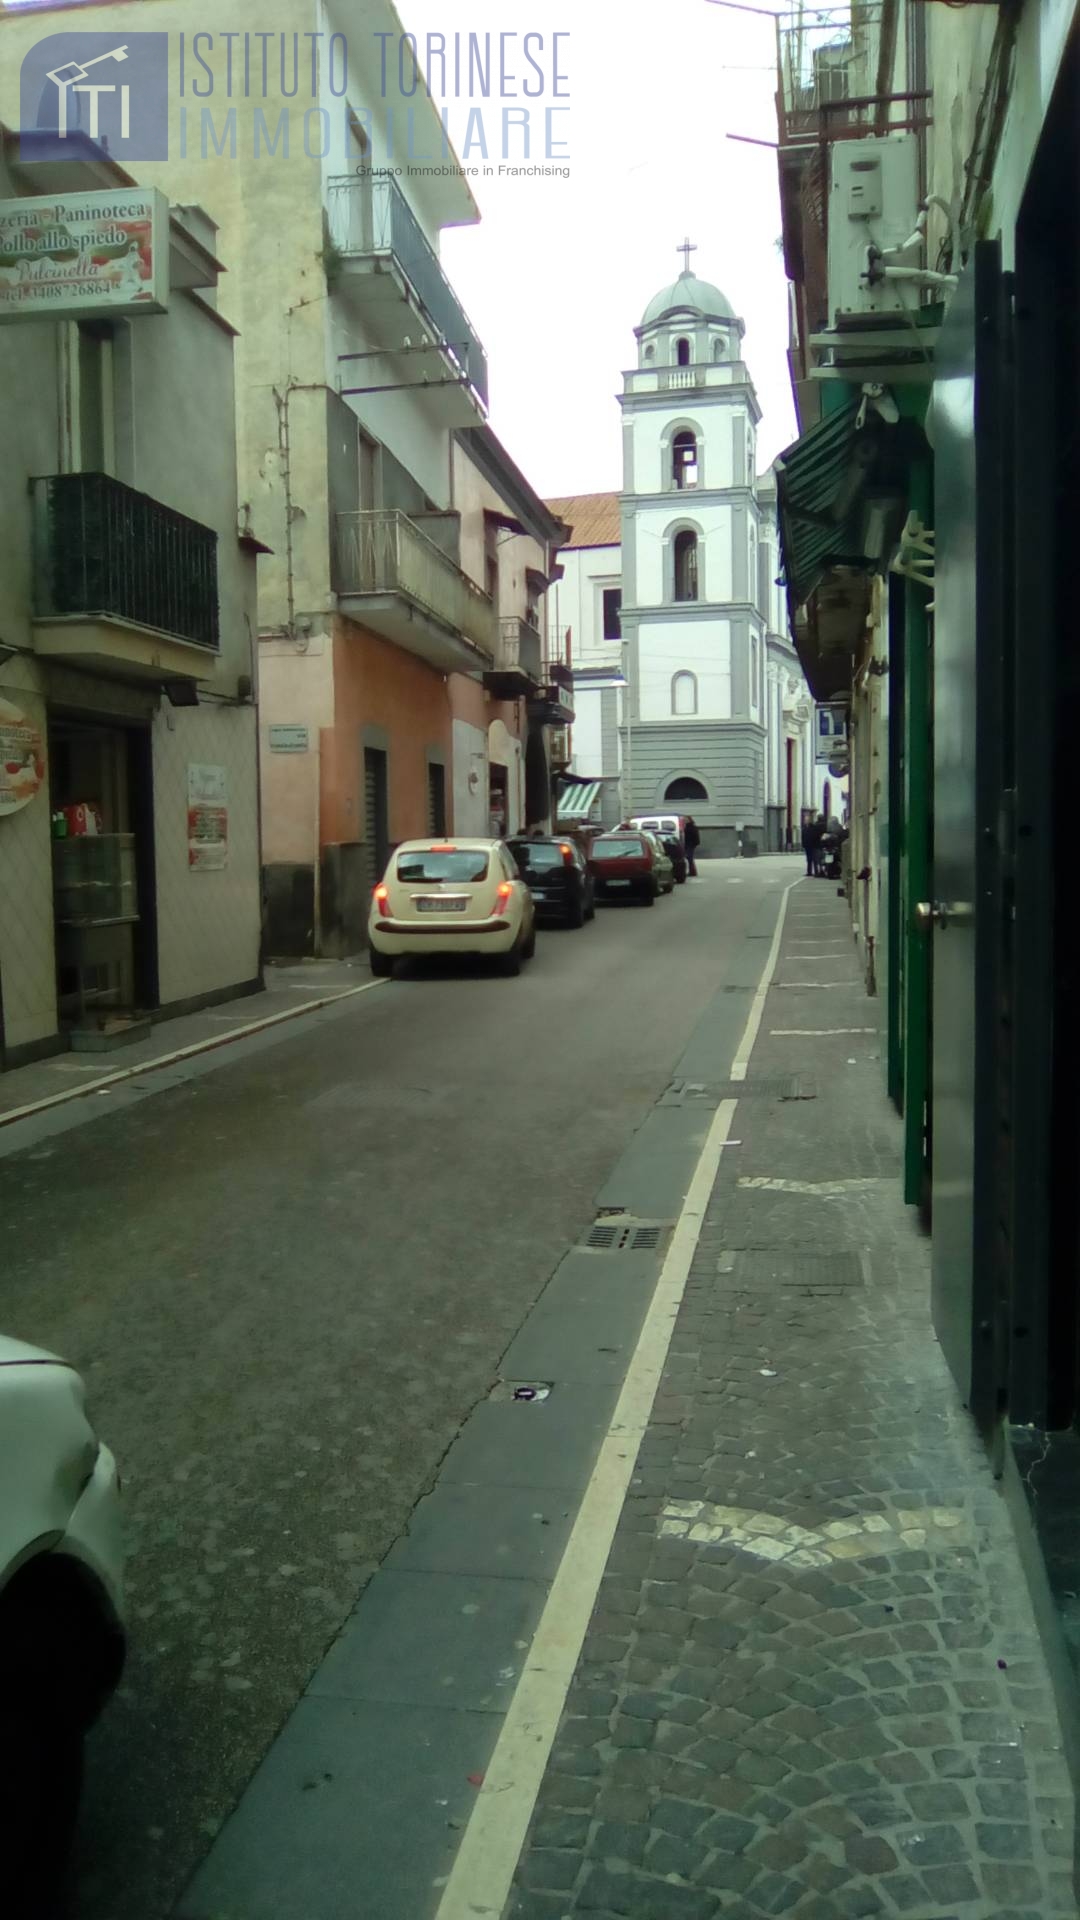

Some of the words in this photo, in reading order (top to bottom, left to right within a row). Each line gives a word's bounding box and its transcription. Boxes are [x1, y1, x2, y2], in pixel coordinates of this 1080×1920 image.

[55, 204, 145, 223] Paninoteca
[38, 231, 68, 250] allo
[72, 225, 126, 251] spiedo
